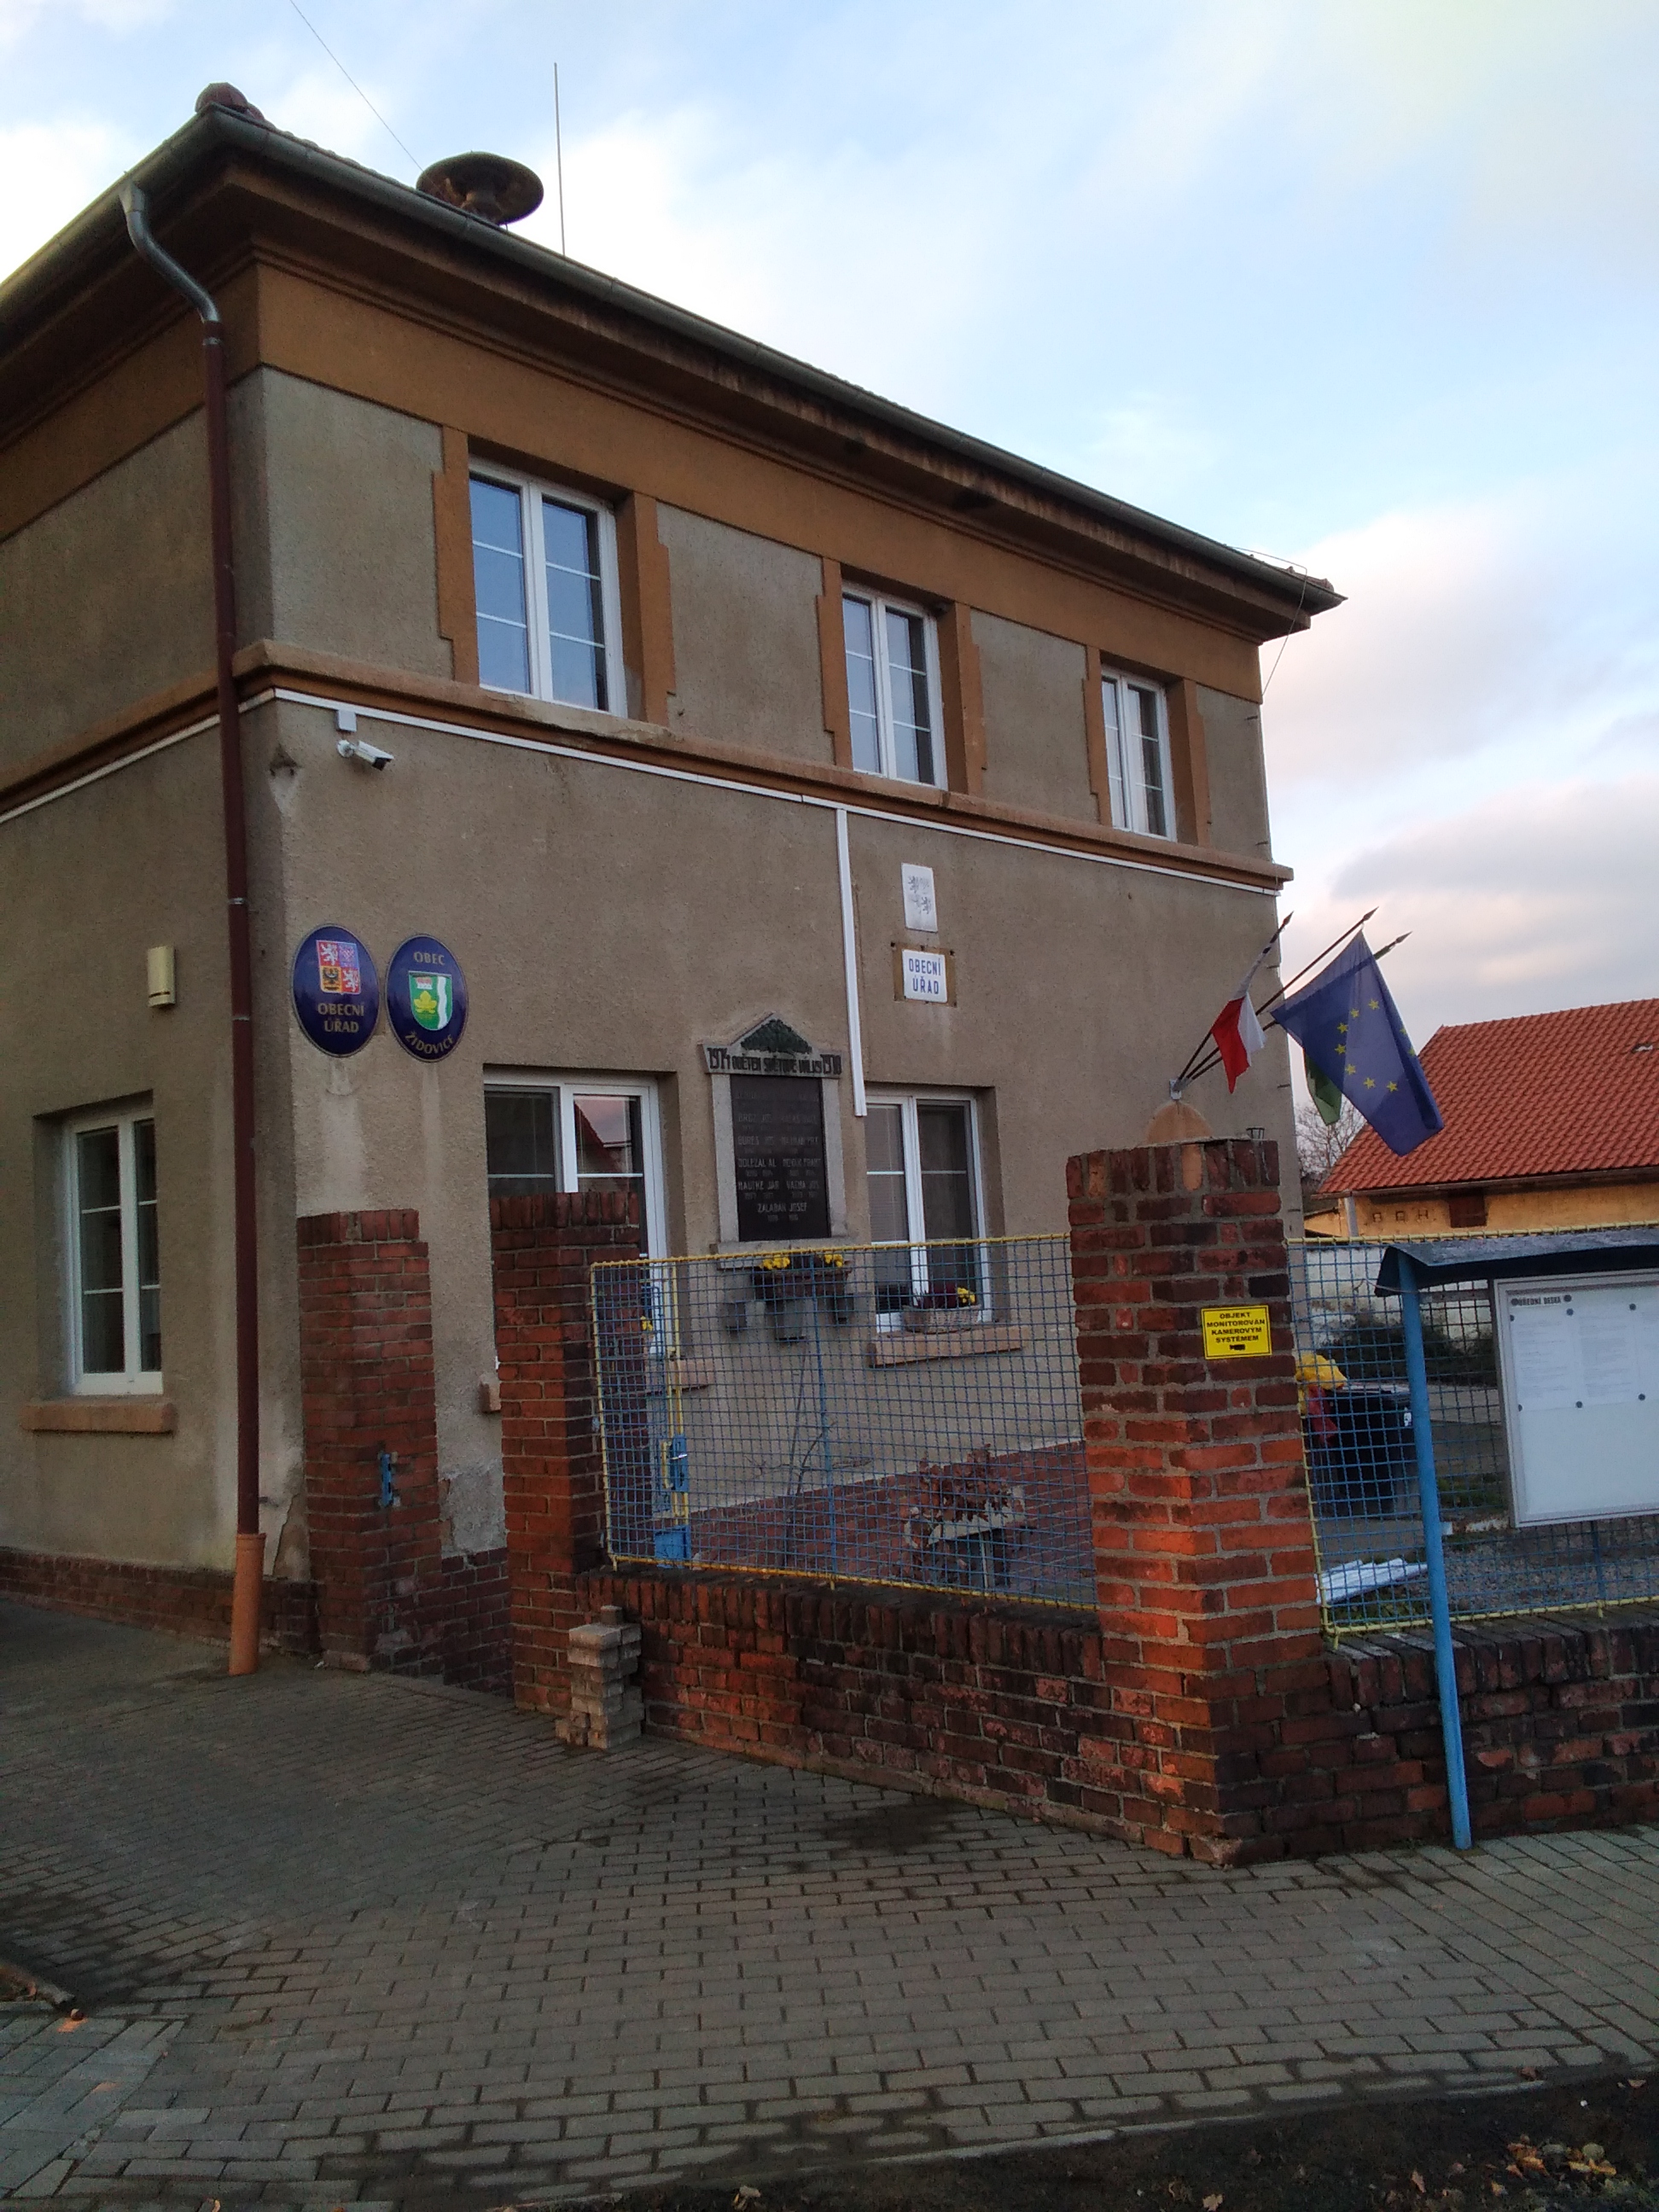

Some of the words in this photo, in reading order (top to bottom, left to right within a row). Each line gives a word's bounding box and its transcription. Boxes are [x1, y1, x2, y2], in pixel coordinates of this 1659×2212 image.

[413, 951, 445, 966] OBEC
[908, 958, 941, 975] OBECNÍ
[912, 975, 940, 994] ÚŘAD
[317, 1001, 364, 1016] OBECNÍ
[323, 1018, 359, 1033] ÚŘAD
[405, 1030, 454, 1055] ŽIDOVICE
